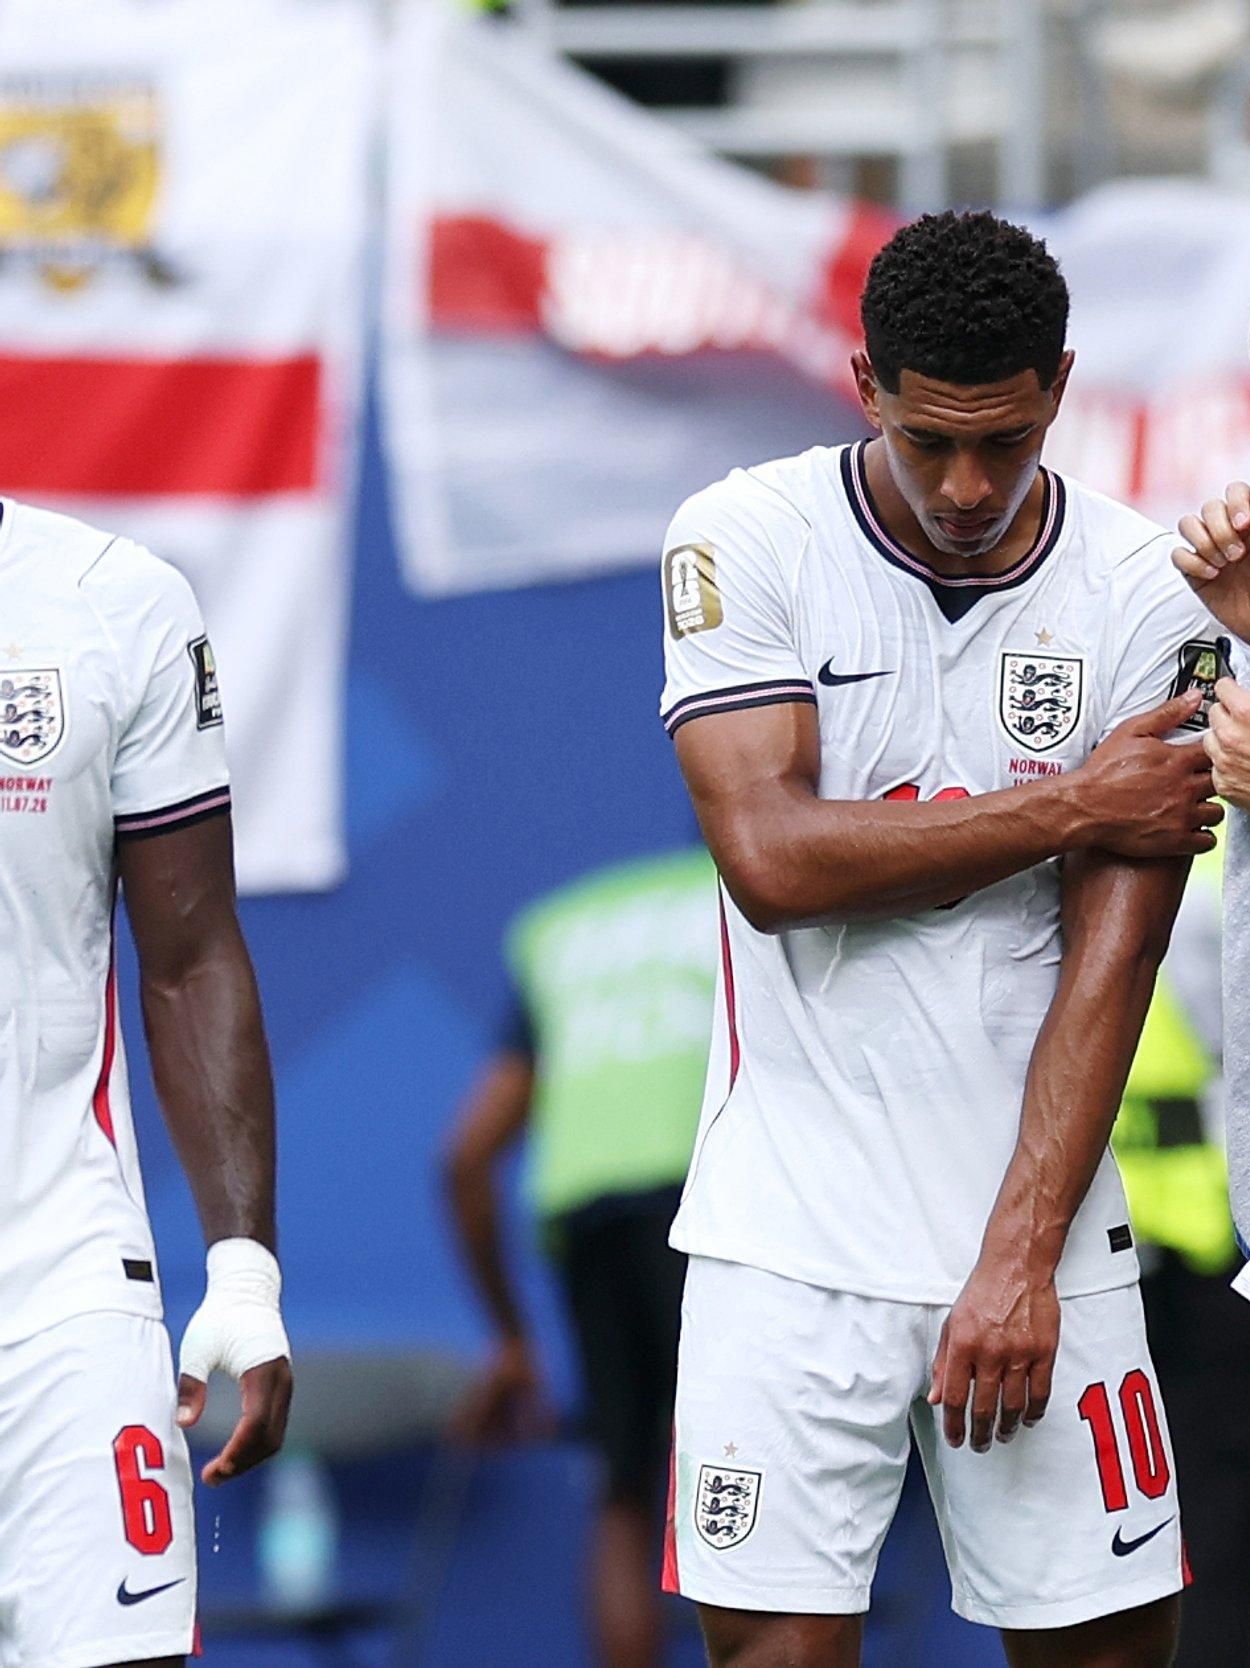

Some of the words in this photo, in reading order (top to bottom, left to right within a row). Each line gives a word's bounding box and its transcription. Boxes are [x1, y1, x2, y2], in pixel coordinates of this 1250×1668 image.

[1009, 759, 1062, 775] NORWAY
[112, 1424, 173, 1555] 6
[1077, 1368, 1170, 1513] 10
